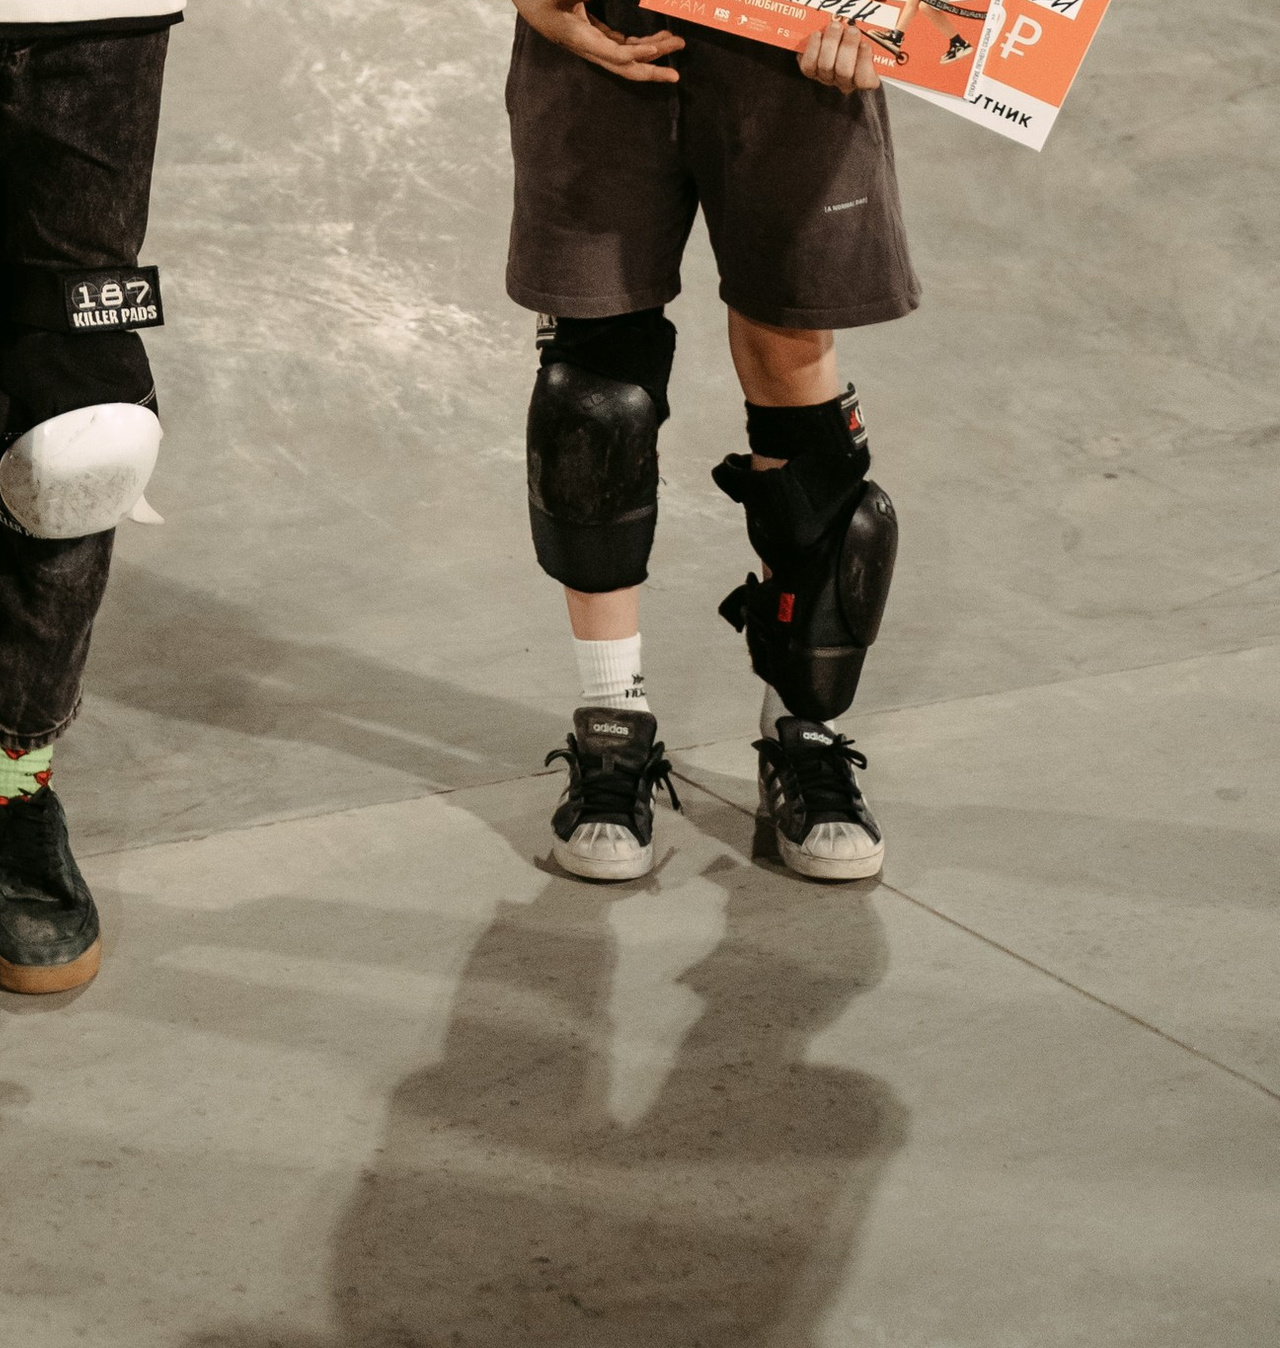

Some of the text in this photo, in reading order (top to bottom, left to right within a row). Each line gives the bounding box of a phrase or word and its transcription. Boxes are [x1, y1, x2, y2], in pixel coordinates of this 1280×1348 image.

[714, 6, 731, 19] KSS
[77, 279, 151, 309] 187
[72, 305, 158, 327] KILLER PADS
[592, 722, 629, 736] adidas
